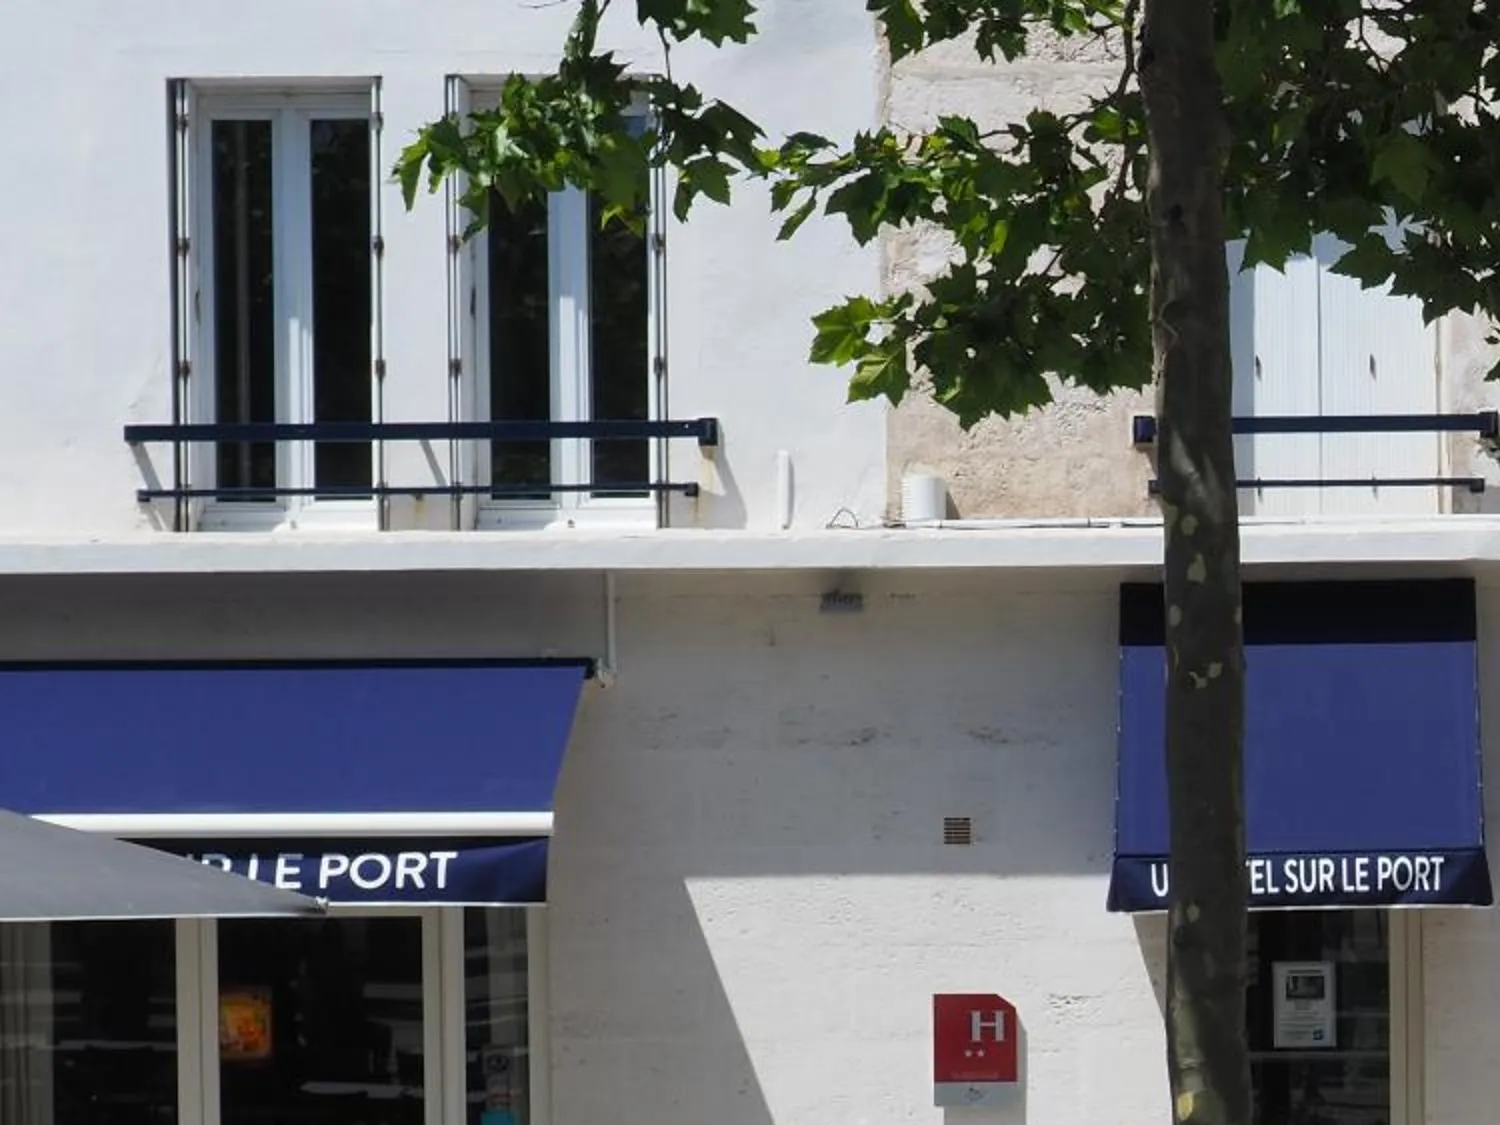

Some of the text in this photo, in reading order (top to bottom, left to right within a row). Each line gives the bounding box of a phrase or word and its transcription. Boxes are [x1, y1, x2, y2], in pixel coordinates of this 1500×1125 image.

[318, 851, 458, 889] PORT
[1284, 859, 1335, 894] SUR
[1341, 858, 1370, 892] LE
[1377, 856, 1444, 892] PORT
[971, 1010, 1005, 1042] H
